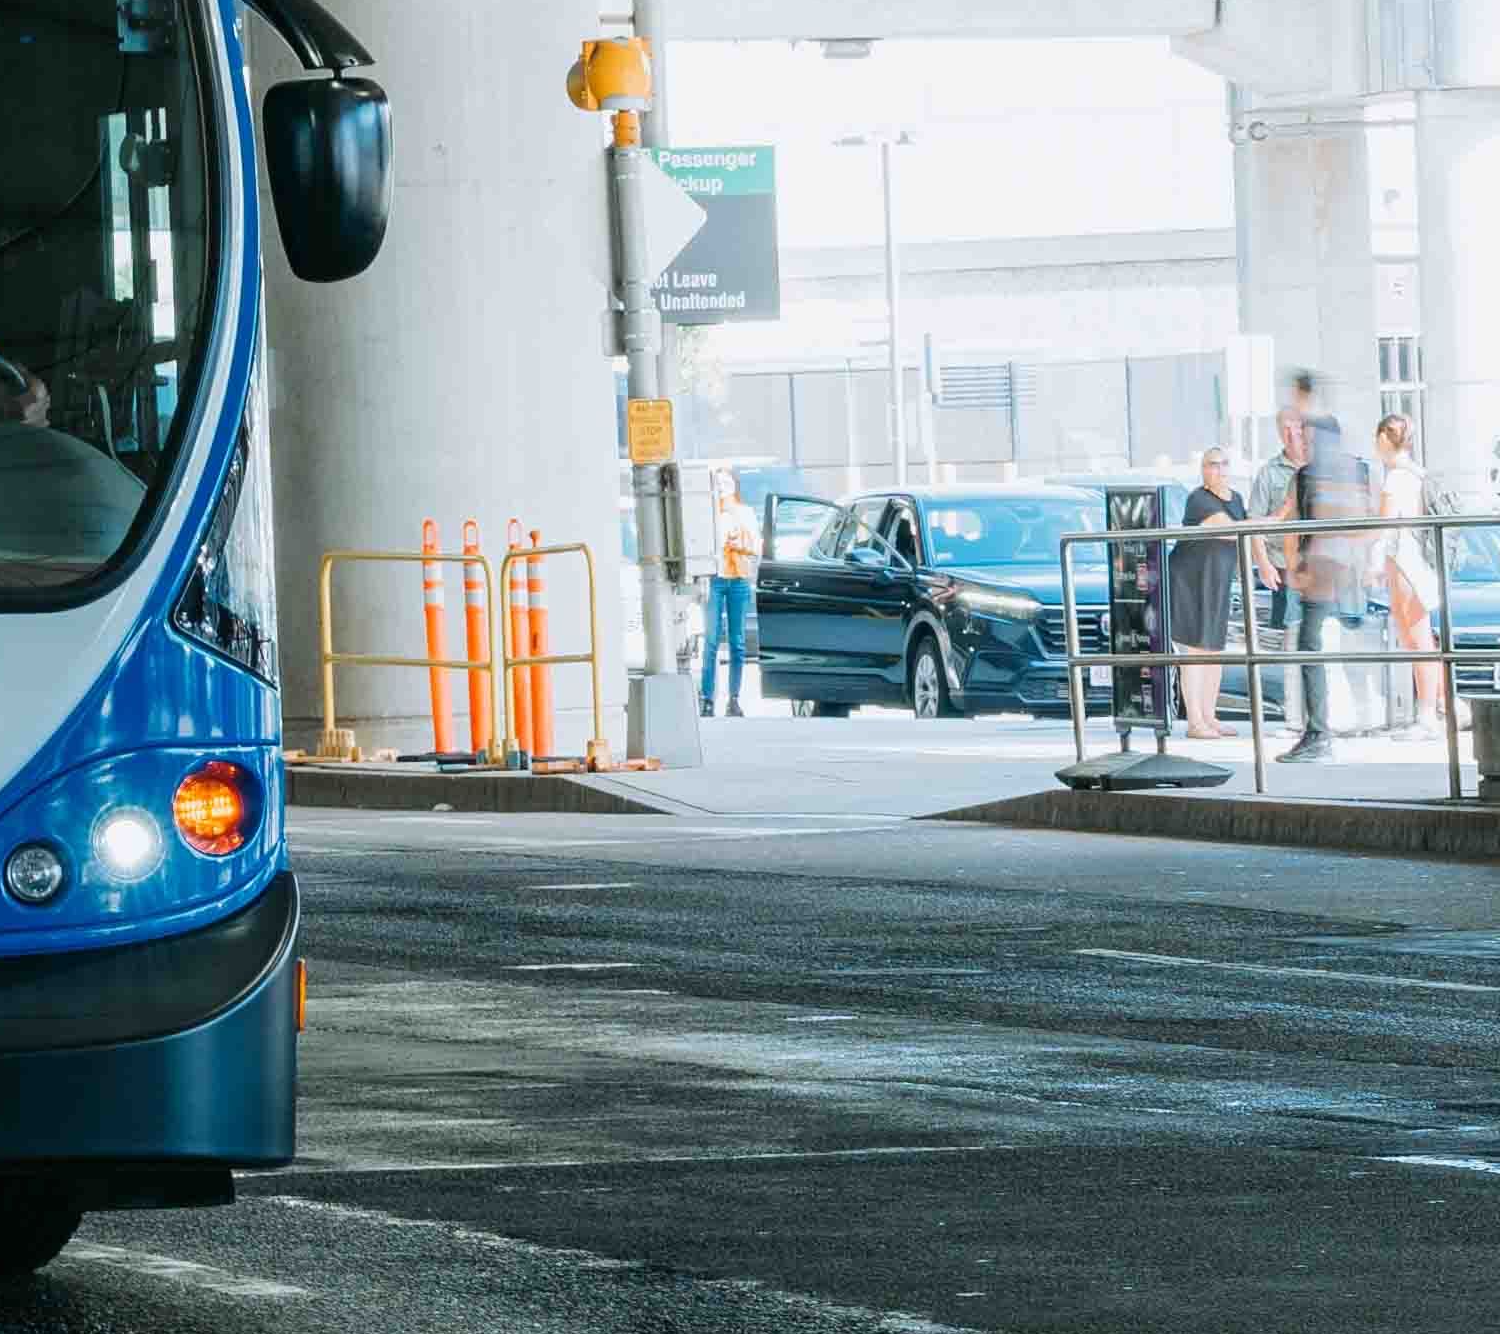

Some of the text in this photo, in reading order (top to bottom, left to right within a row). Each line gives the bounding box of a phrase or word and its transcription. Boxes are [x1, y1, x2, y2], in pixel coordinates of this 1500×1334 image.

[659, 152, 756, 170] Passenger
[672, 271, 718, 289] Leave
[659, 290, 747, 311] Unattended
